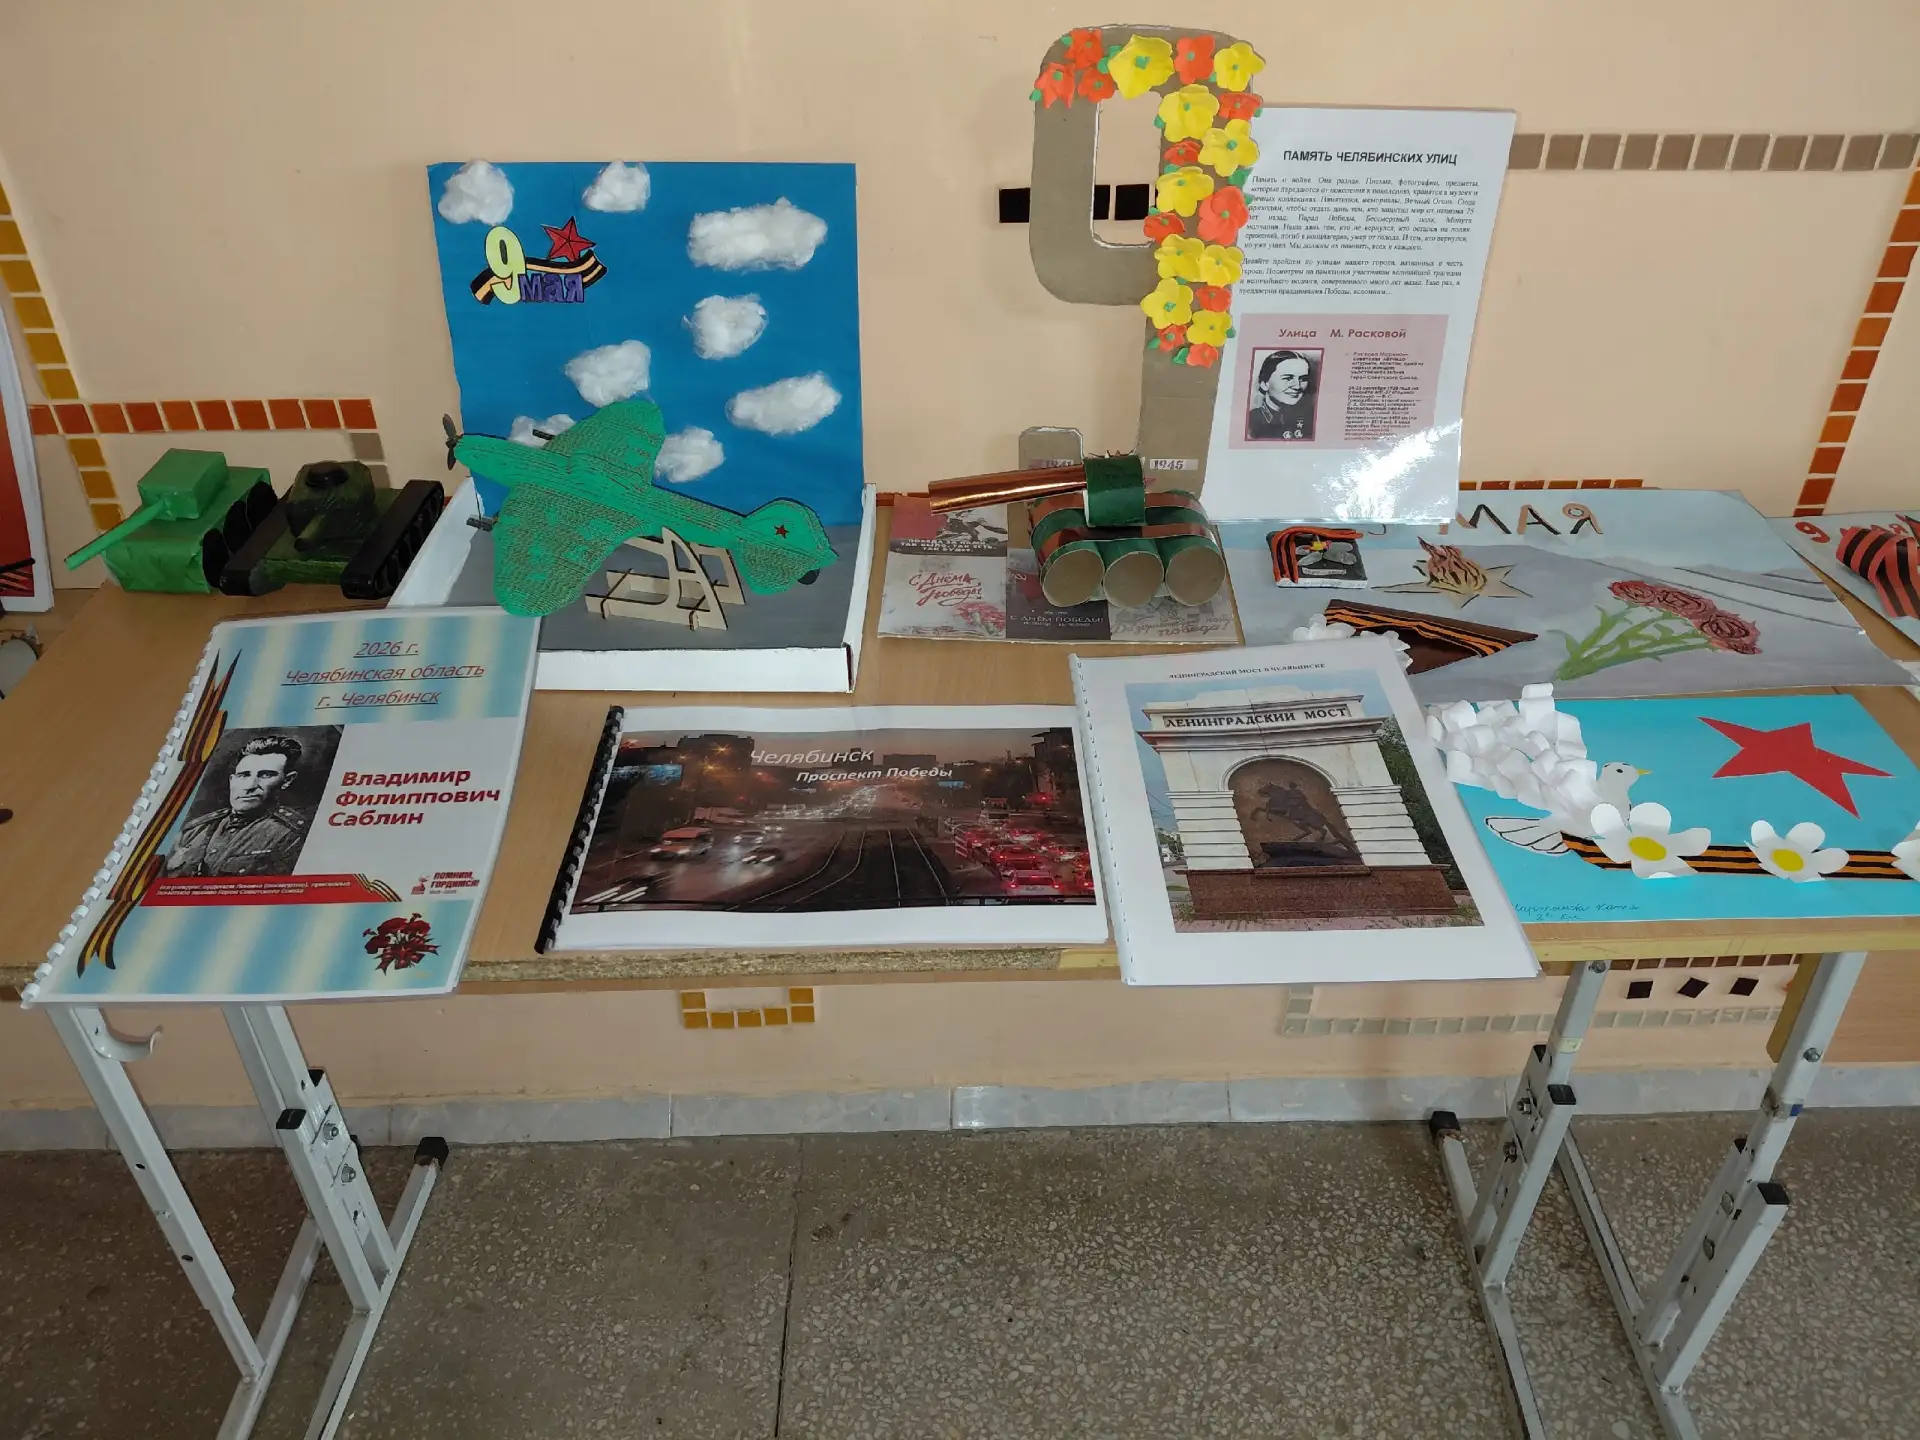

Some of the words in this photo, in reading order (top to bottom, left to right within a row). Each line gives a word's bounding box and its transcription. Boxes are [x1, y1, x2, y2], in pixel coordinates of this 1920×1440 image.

[1283, 150, 1332, 162] ПАМЯТЬ
[1336, 152, 1422, 164] ЧЕЛЯБИНСКИХ
[1426, 153, 1457, 165] УЛИЦ
[485, 226, 526, 304] 9
[1278, 329, 1317, 338] Улица
[1330, 329, 1344, 338] М.
[1348, 328, 1406, 338] Расковой
[1154, 460, 1184, 470] 1945
[1794, 521, 1830, 544] 9
[908, 574, 919, 586] С
[356, 641, 403, 656] 2026
[406, 643, 419, 654] г.
[286, 668, 406, 683] Челябинская
[410, 664, 485, 678] область
[1169, 669, 1238, 679] ЛЕНИНГРАДСКИЙ
[1270, 663, 1326, 672] ЧЕЛЯБИНСКЕ
[317, 697, 330, 707] г.
[342, 690, 442, 706] Челябинск
[1166, 712, 1296, 728] ЛЕНИНГРАДСКИЙ
[1304, 707, 1348, 720] МОСТ
[750, 748, 874, 766] Челябинск
[341, 770, 470, 787] Владимир
[796, 769, 882, 784] Проспект
[886, 766, 953, 779] Победы
[335, 790, 500, 807] Филиппович
[328, 810, 424, 827] Саблин
